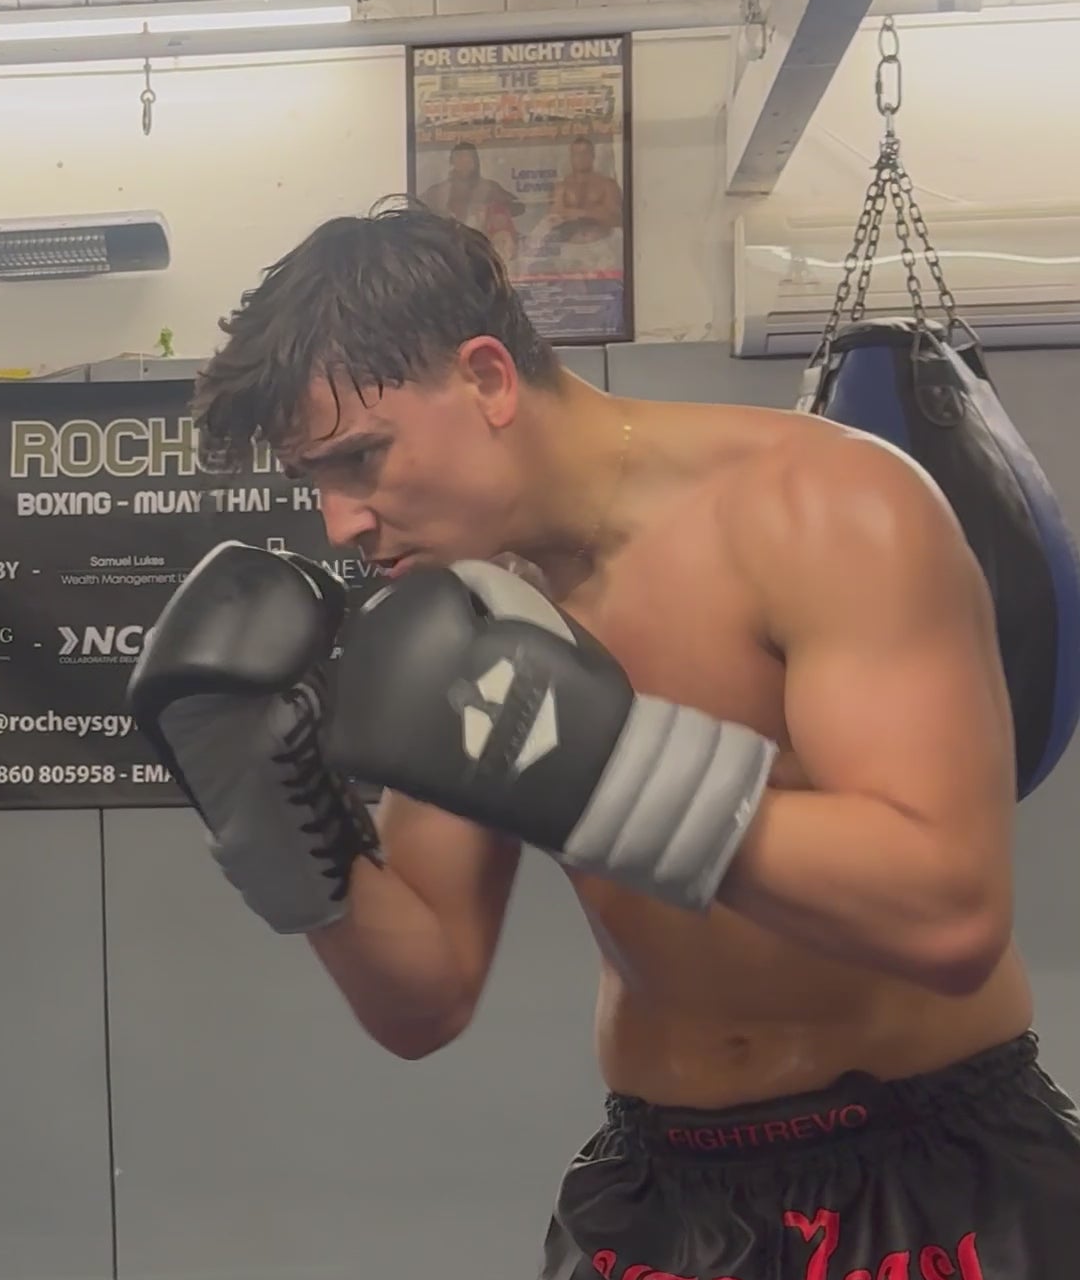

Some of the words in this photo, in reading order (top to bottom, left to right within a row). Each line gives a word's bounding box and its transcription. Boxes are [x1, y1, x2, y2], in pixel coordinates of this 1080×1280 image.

[414, 48, 451, 66] FOR
[457, 46, 498, 64] ONE
[502, 43, 565, 62] NIGHT
[571, 39, 622, 58] ONLY
[498, 71, 538, 88] THE
[17, 492, 112, 516] BOXING
[133, 489, 202, 514] MUAY
[209, 487, 270, 513] THAI
[90, 555, 132, 568] Samuel
[61, 574, 99, 585] Wealth
[102, 573, 176, 587] Management
[59, 656, 118, 664] COLLABORATIVE
[38, 765, 116, 783] 805958
[668, 1104, 869, 1150] FIGHTREVO
